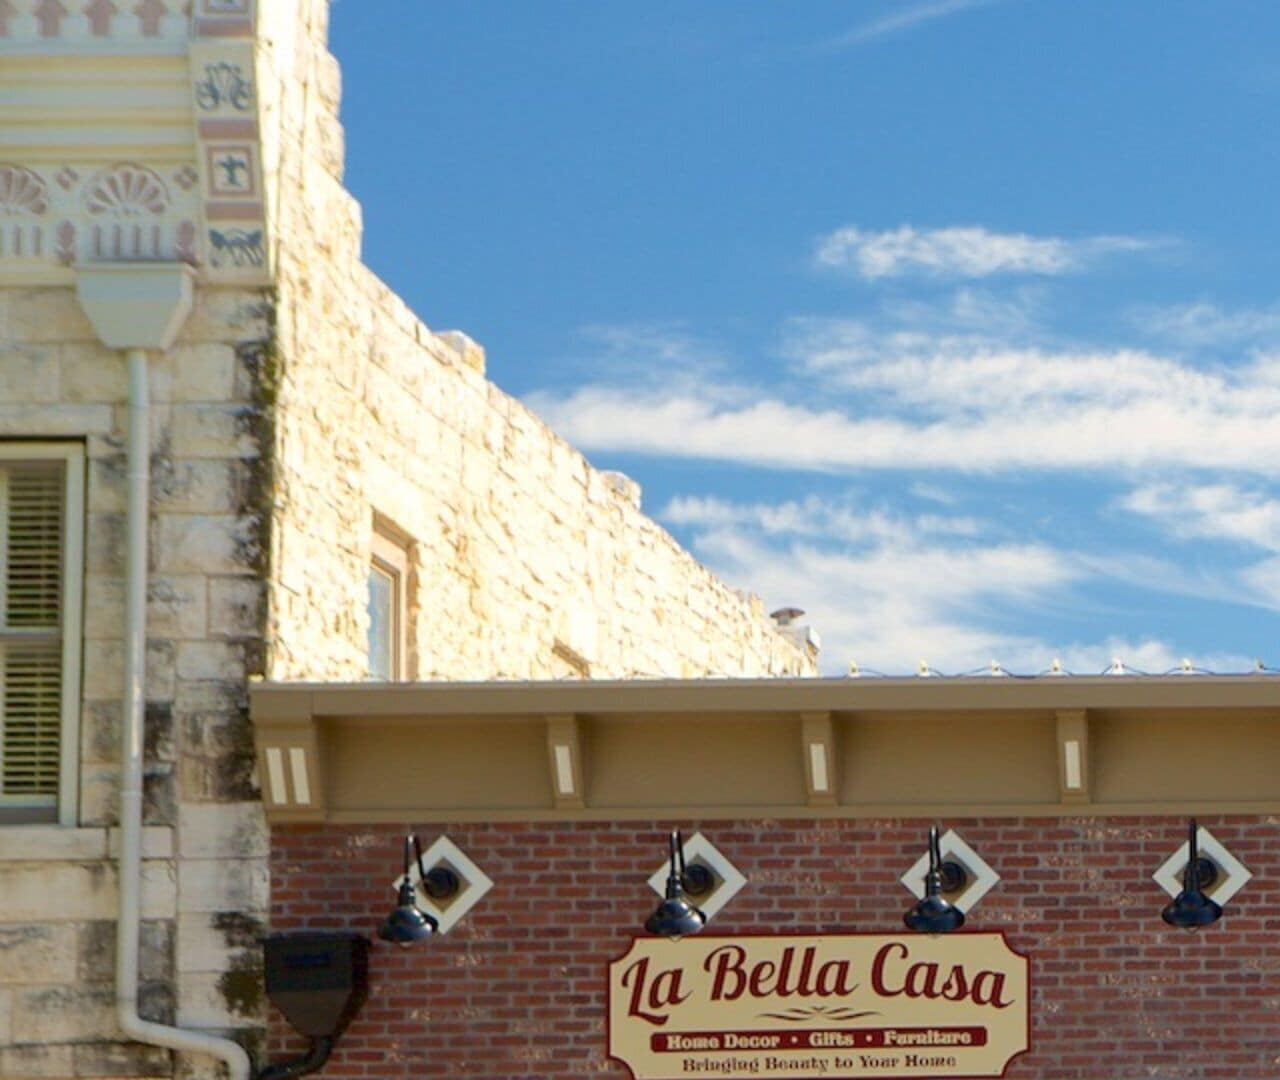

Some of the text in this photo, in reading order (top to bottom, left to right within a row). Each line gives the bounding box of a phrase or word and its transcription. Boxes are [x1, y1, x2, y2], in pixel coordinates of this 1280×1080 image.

[620, 941, 1016, 1026] La Bella Casa
[666, 1029, 972, 1051] Home Decor Gifts Furniture
[682, 1053, 957, 1074] Bringing Beauty to Your Home
